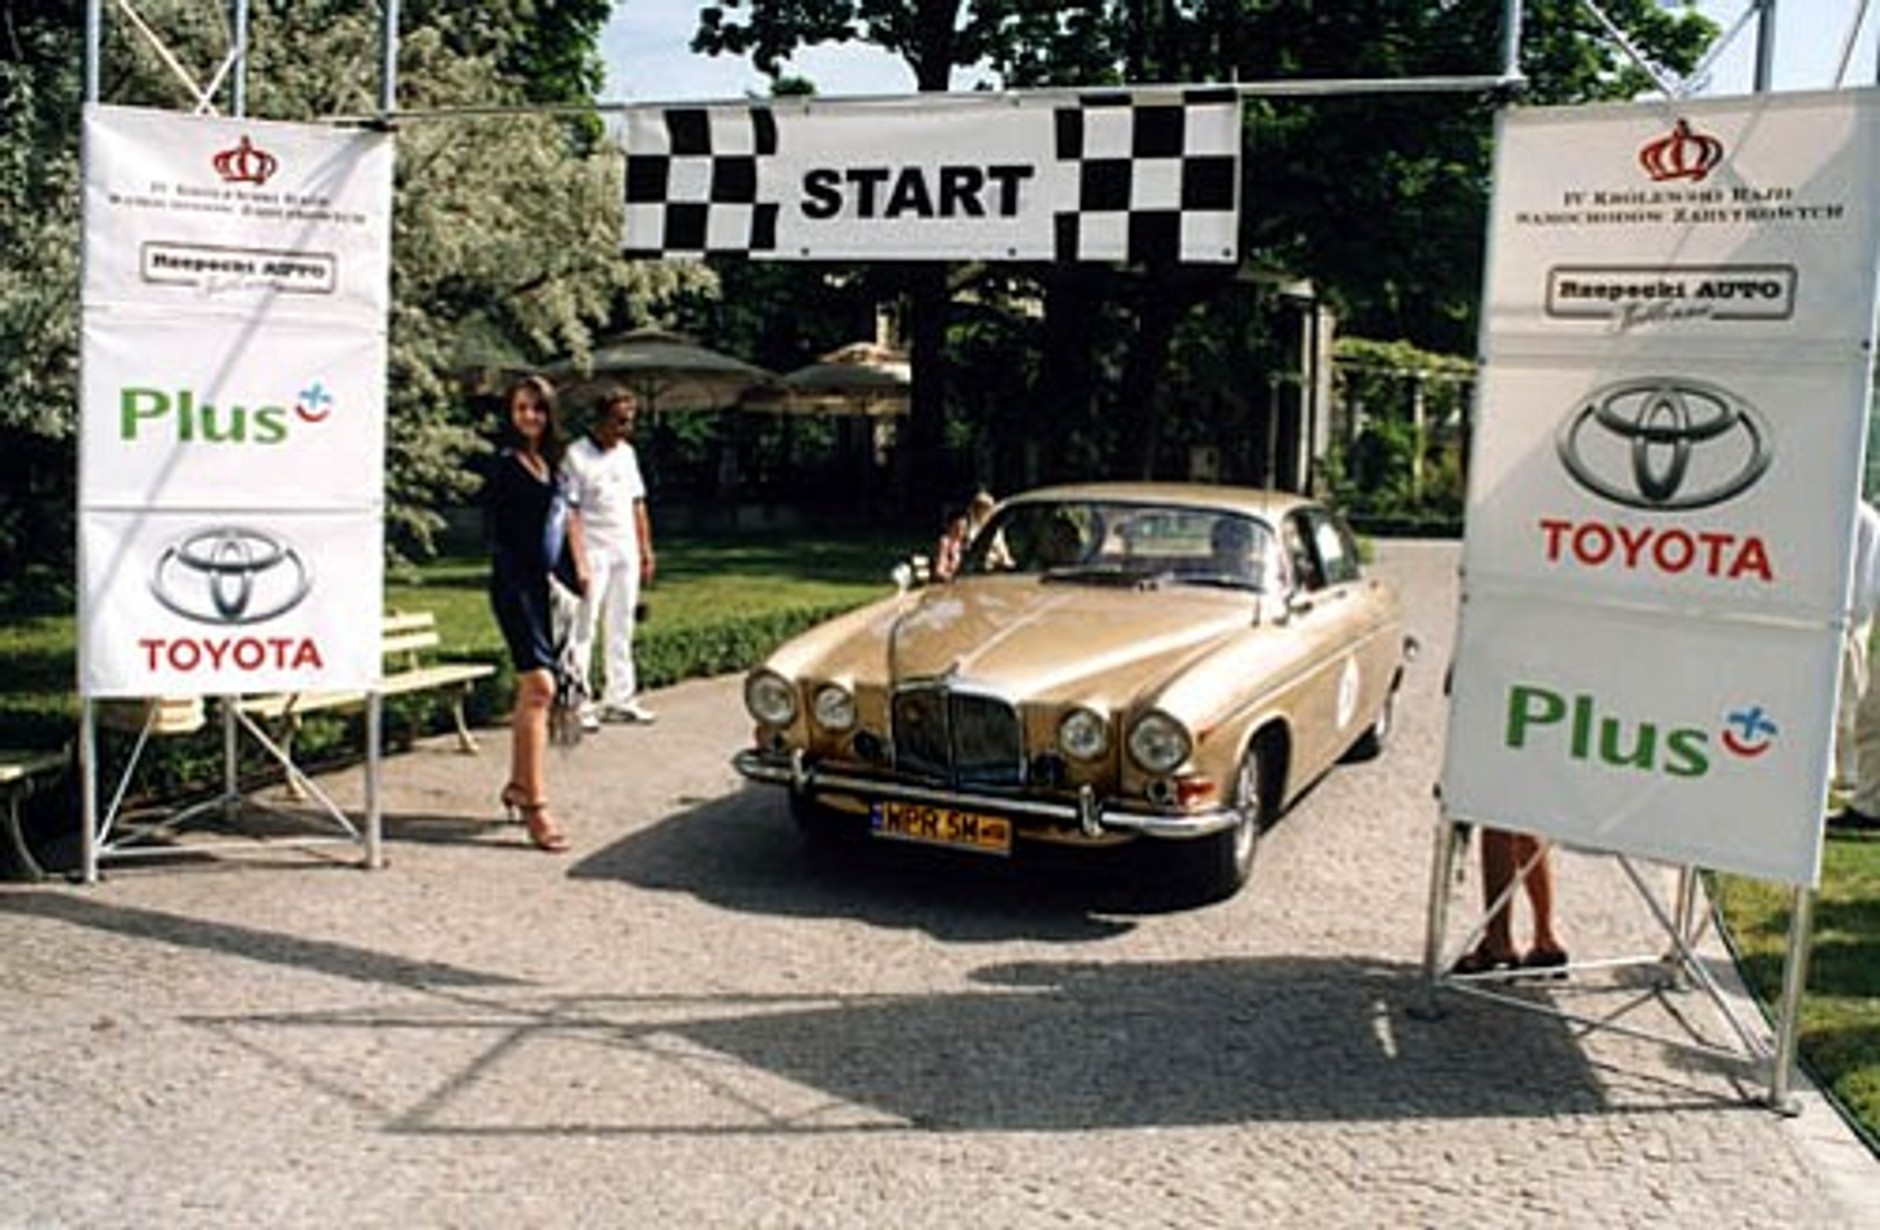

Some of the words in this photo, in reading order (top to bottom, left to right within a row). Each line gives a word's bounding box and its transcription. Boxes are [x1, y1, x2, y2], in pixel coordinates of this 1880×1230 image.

[800, 165, 1034, 219] START
[1696, 281, 1783, 299] AUTO
[120, 387, 288, 443] Plus
[1540, 519, 1773, 582] TOYOTA
[138, 637, 324, 671] TOYOTA
[1504, 683, 1710, 778] Plus
